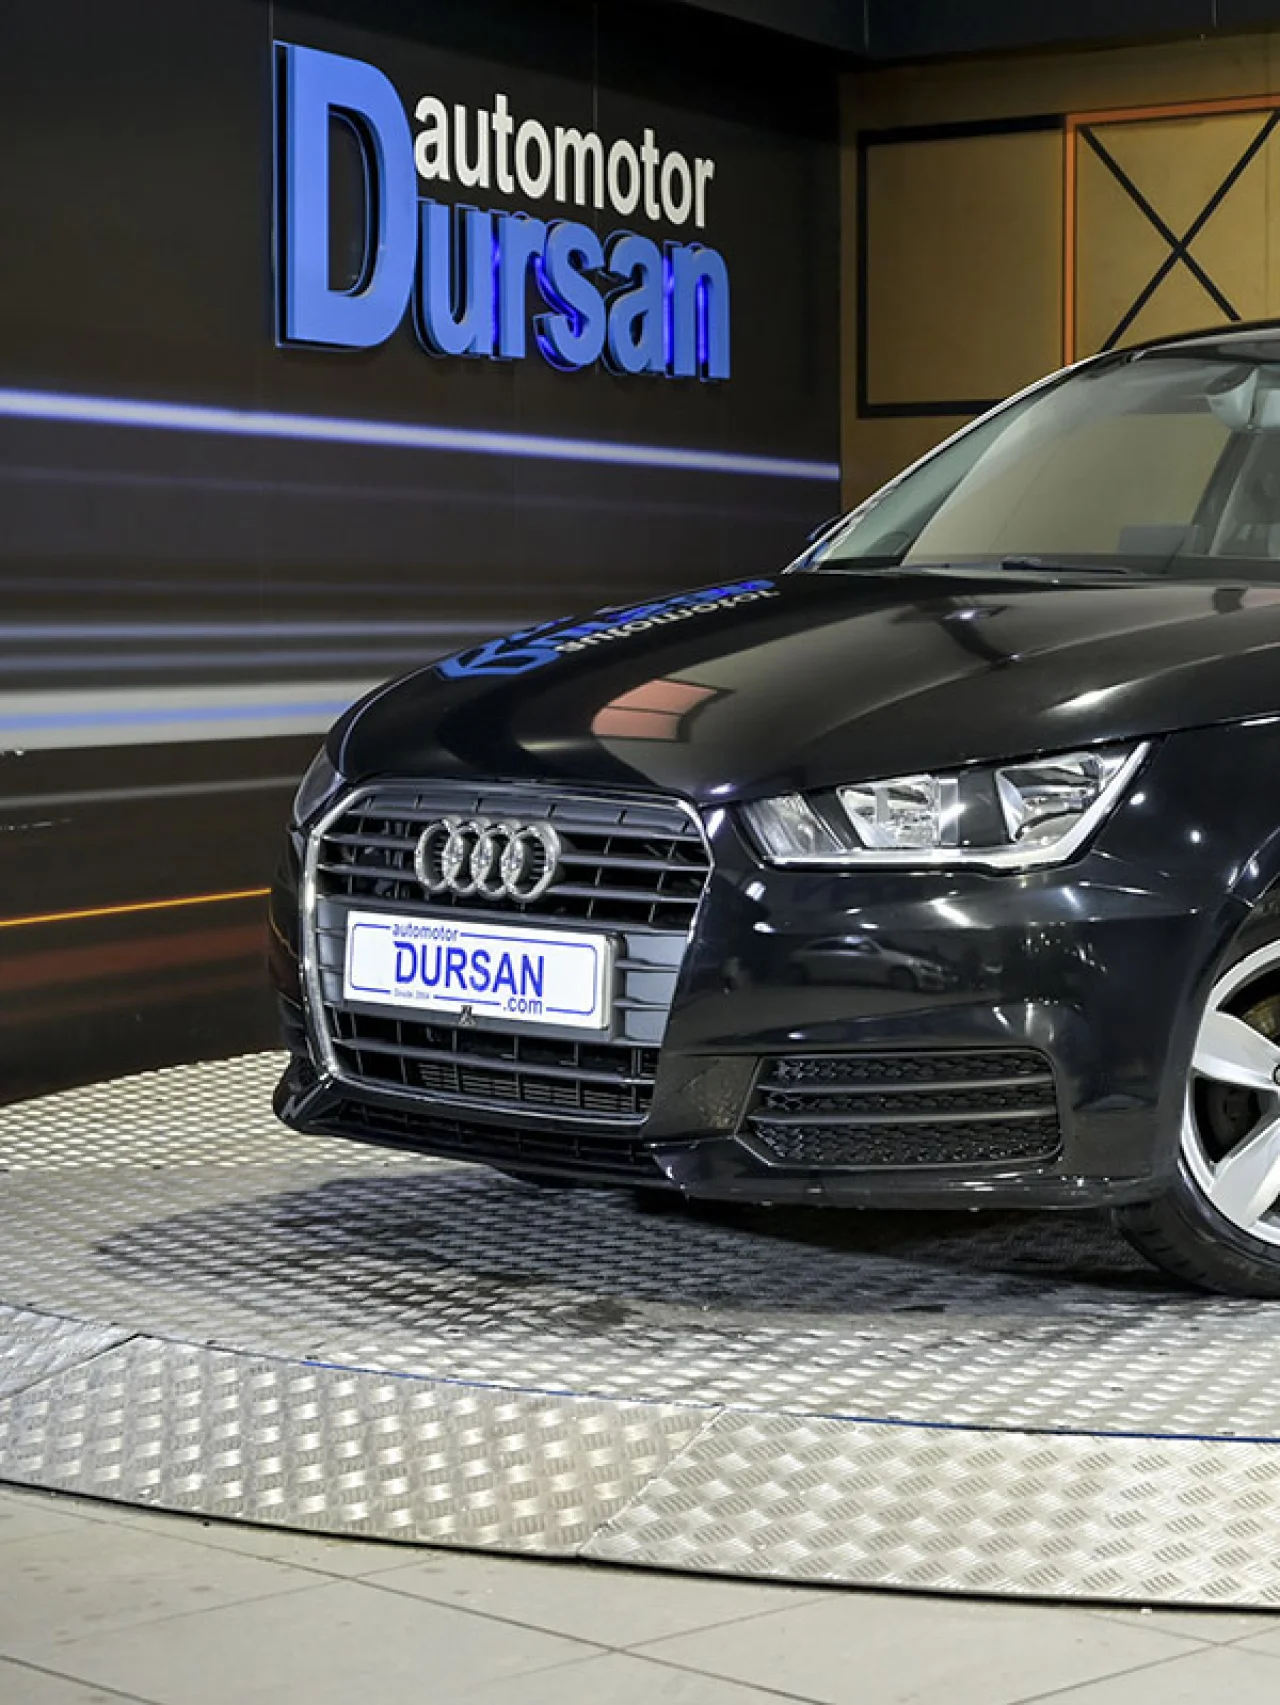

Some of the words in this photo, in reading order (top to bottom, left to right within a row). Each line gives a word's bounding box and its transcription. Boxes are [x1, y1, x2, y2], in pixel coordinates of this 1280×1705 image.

[414, 94, 714, 227] automotor
[274, 40, 731, 380] Dursan
[391, 923, 459, 941] automotor
[393, 941, 544, 997] DURSAN
[503, 997, 543, 1014] .com
